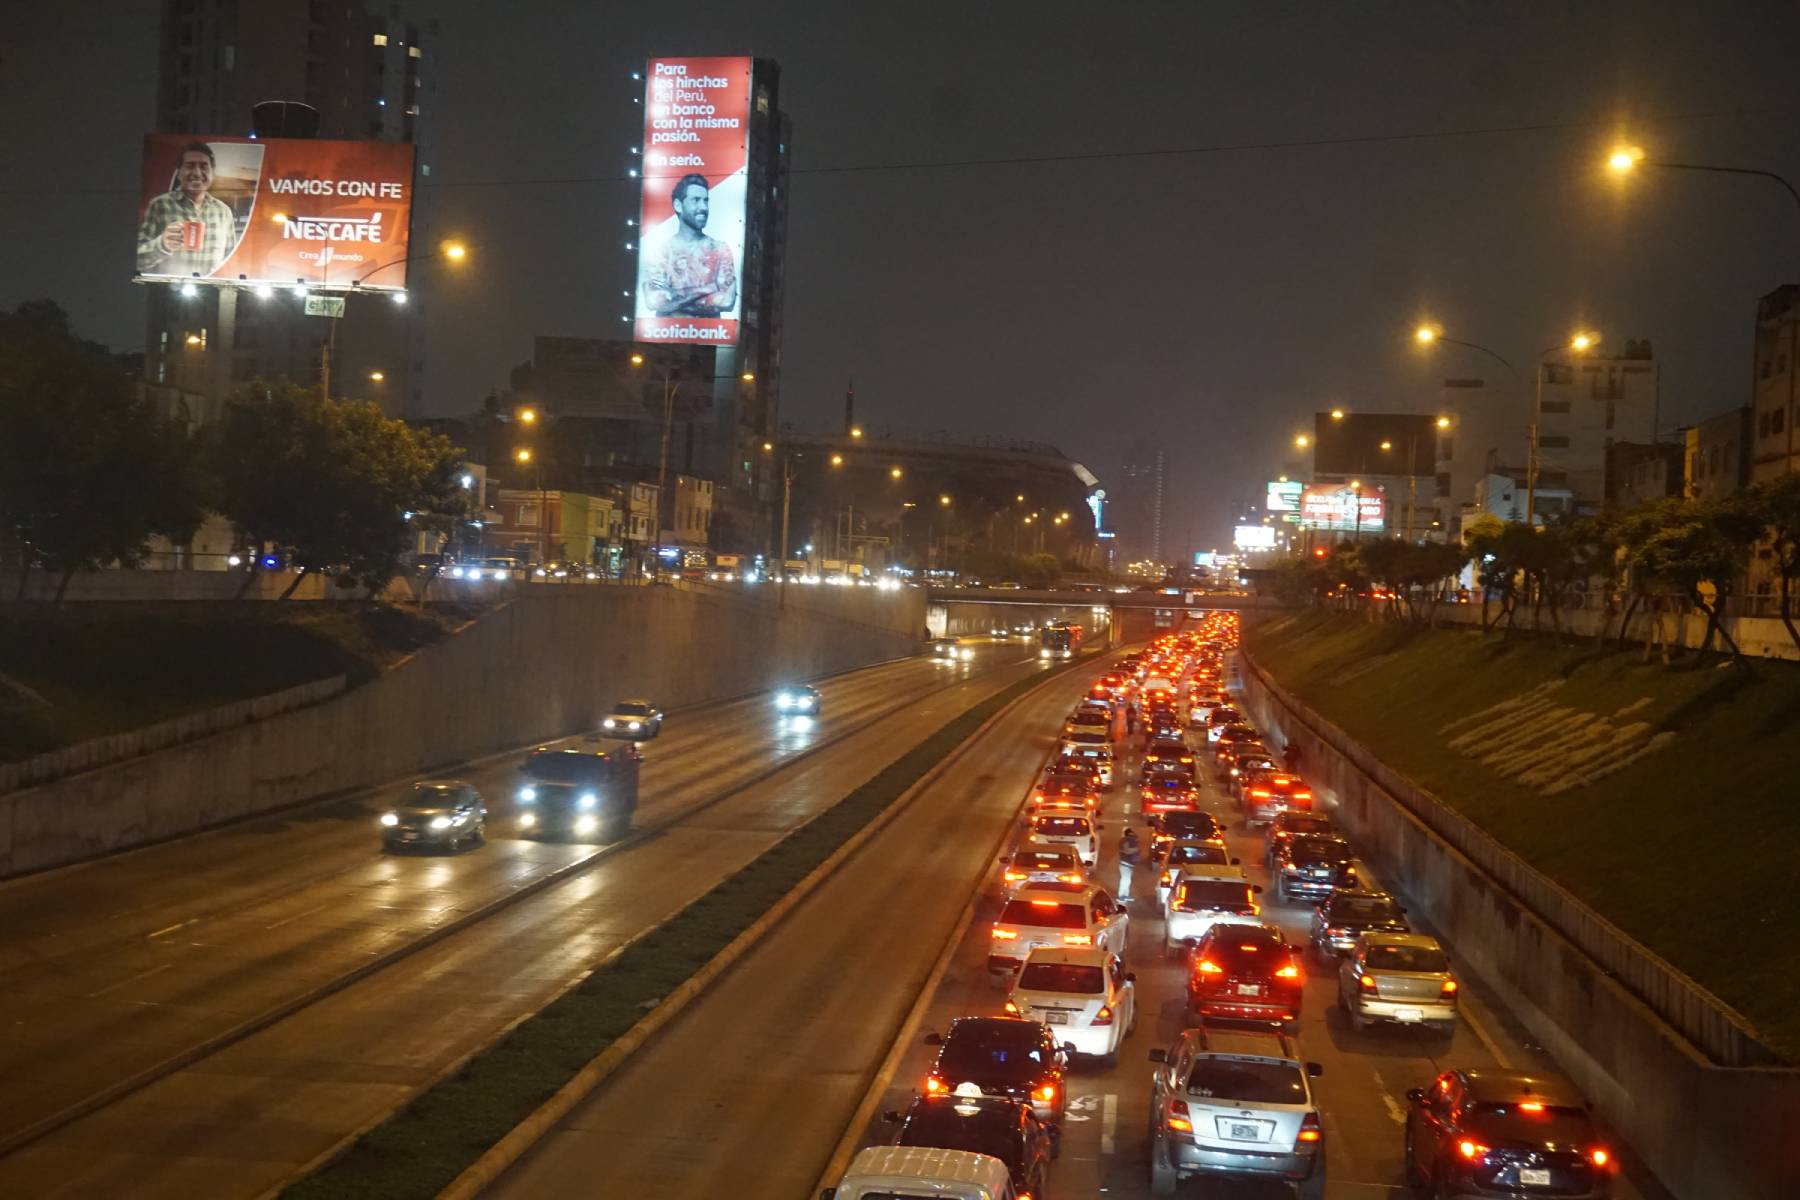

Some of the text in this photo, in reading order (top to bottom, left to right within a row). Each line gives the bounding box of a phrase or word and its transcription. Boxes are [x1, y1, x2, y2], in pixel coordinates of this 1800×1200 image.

[655, 63, 687, 75] Para
[653, 76, 728, 88] los hinchas
[672, 103, 715, 115] banco
[652, 116, 739, 129] con la misma
[652, 129, 701, 144] pasión.
[669, 153, 704, 166] serio.
[269, 179, 402, 199] VAMOS CON FE
[283, 212, 382, 243] NESCAFÉ
